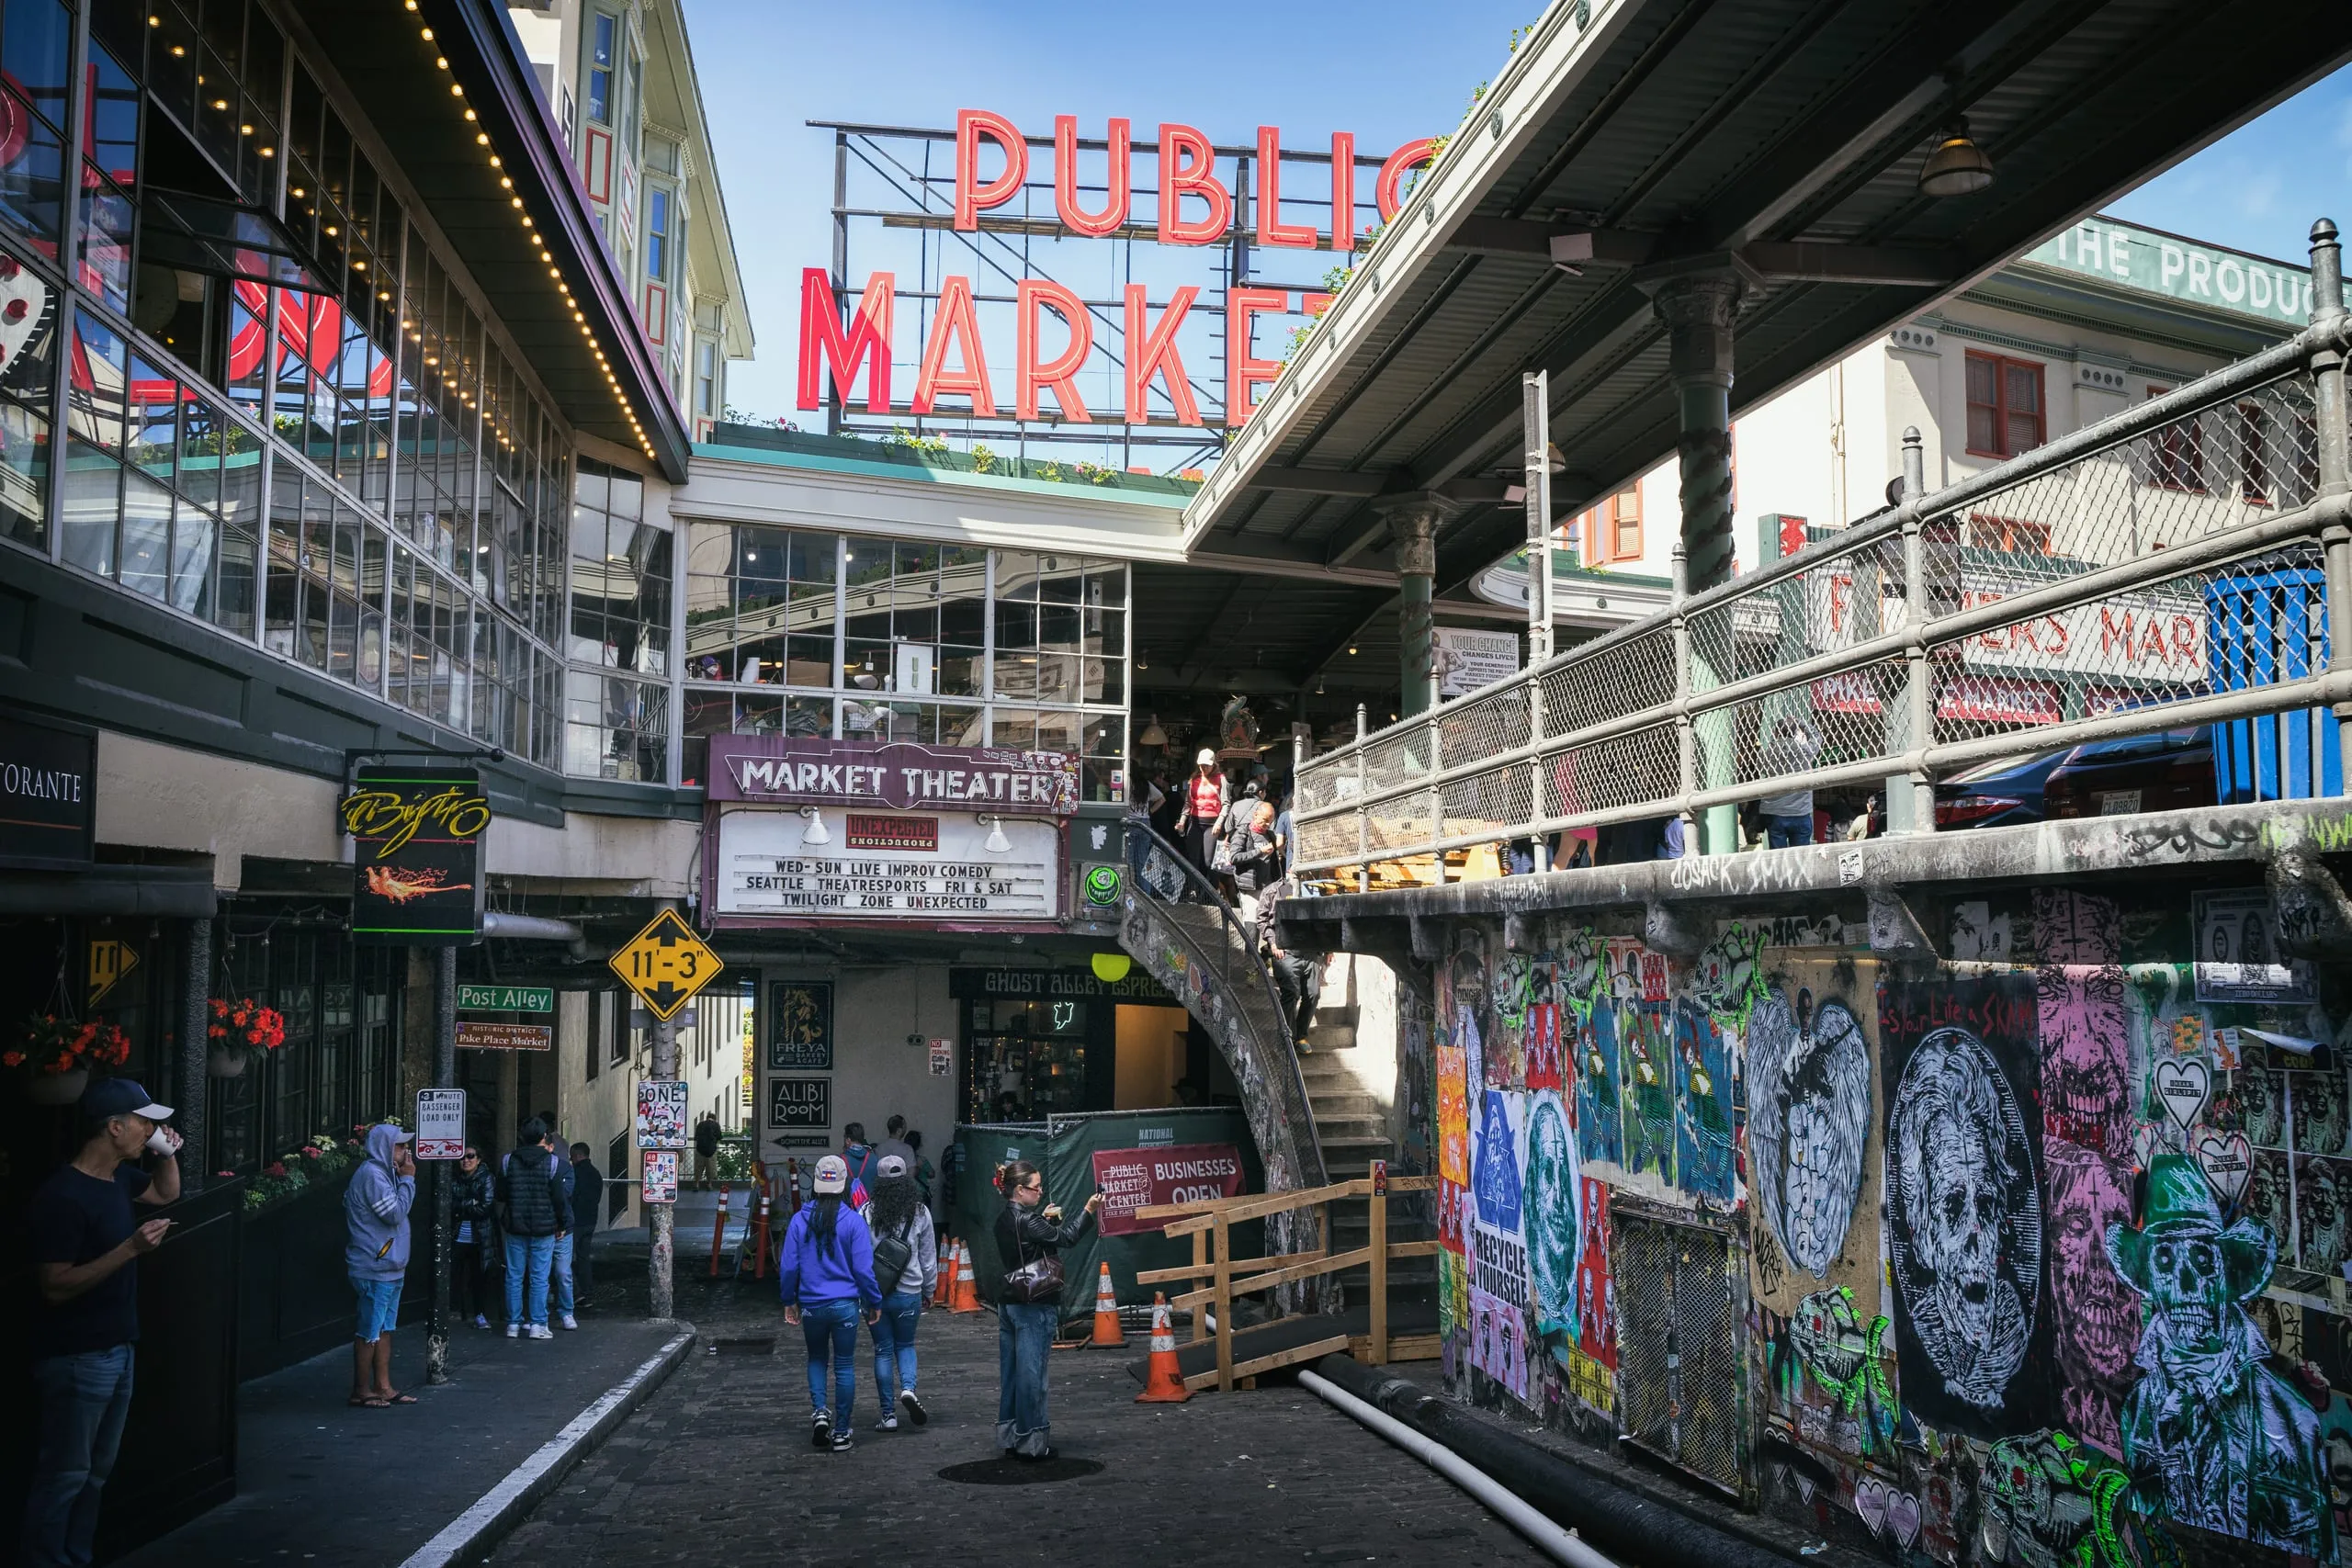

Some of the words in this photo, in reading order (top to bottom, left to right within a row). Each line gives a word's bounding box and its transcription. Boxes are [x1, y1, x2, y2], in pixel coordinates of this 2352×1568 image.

[1450, 634, 1477, 650] YOUR
[1478, 637, 1516, 655] CHANGE
[1462, 650, 1494, 660] CHANGES
[0, 762, 81, 802] ORANTE
[742, 760, 888, 795] MARKET
[900, 767, 1052, 804] THEATER
[851, 818, 934, 837] UNEXPECTED
[851, 837, 933, 847] PRODUCTIONS
[775, 861, 810, 873] WED-
[815, 862, 842, 874] SUN
[851, 863, 880, 874] LIVE
[888, 864, 936, 876] IMPROV
[940, 865, 992, 878] COMEDY
[746, 876, 804, 889] SEATTLE
[818, 878, 927, 892] THEATRESPORTS
[945, 881, 965, 893] FRI
[974, 882, 982, 894] &
[989, 883, 1012, 894] SAT
[782, 893, 846, 906] TWILIGHT
[860, 895, 893, 908] ZONE
[907, 896, 988, 908] UNEXPECTED
[985, 972, 1045, 993] GHOST
[1050, 973, 1104, 995] ALLEY
[461, 987, 497, 1006] Post
[503, 989, 548, 1010] Alley
[459, 1033, 481, 1043] Pike
[483, 1034, 510, 1044] Place
[511, 1035, 548, 1046] Market
[776, 1043, 826, 1053] FREYA
[422, 1092, 430, 1100] 3
[645, 1088, 681, 1102] ONE
[777, 1083, 824, 1102] ALIBI
[422, 1102, 460, 1111] PASSENGER
[645, 1105, 681, 1121] WY
[775, 1103, 824, 1122] ROOM
[422, 1113, 440, 1122] LOAD
[1138, 1127, 1174, 1140] NATIONAL
[1110, 1163, 1144, 1178] PUBLIC
[1154, 1158, 1237, 1181] BUSINESSES
[1102, 1179, 1138, 1194] MARKET
[1108, 1194, 1147, 1208] CENTER
[1476, 1228, 1527, 1280] RECYCLE
[1476, 1260, 1527, 1311] YOURSELF
